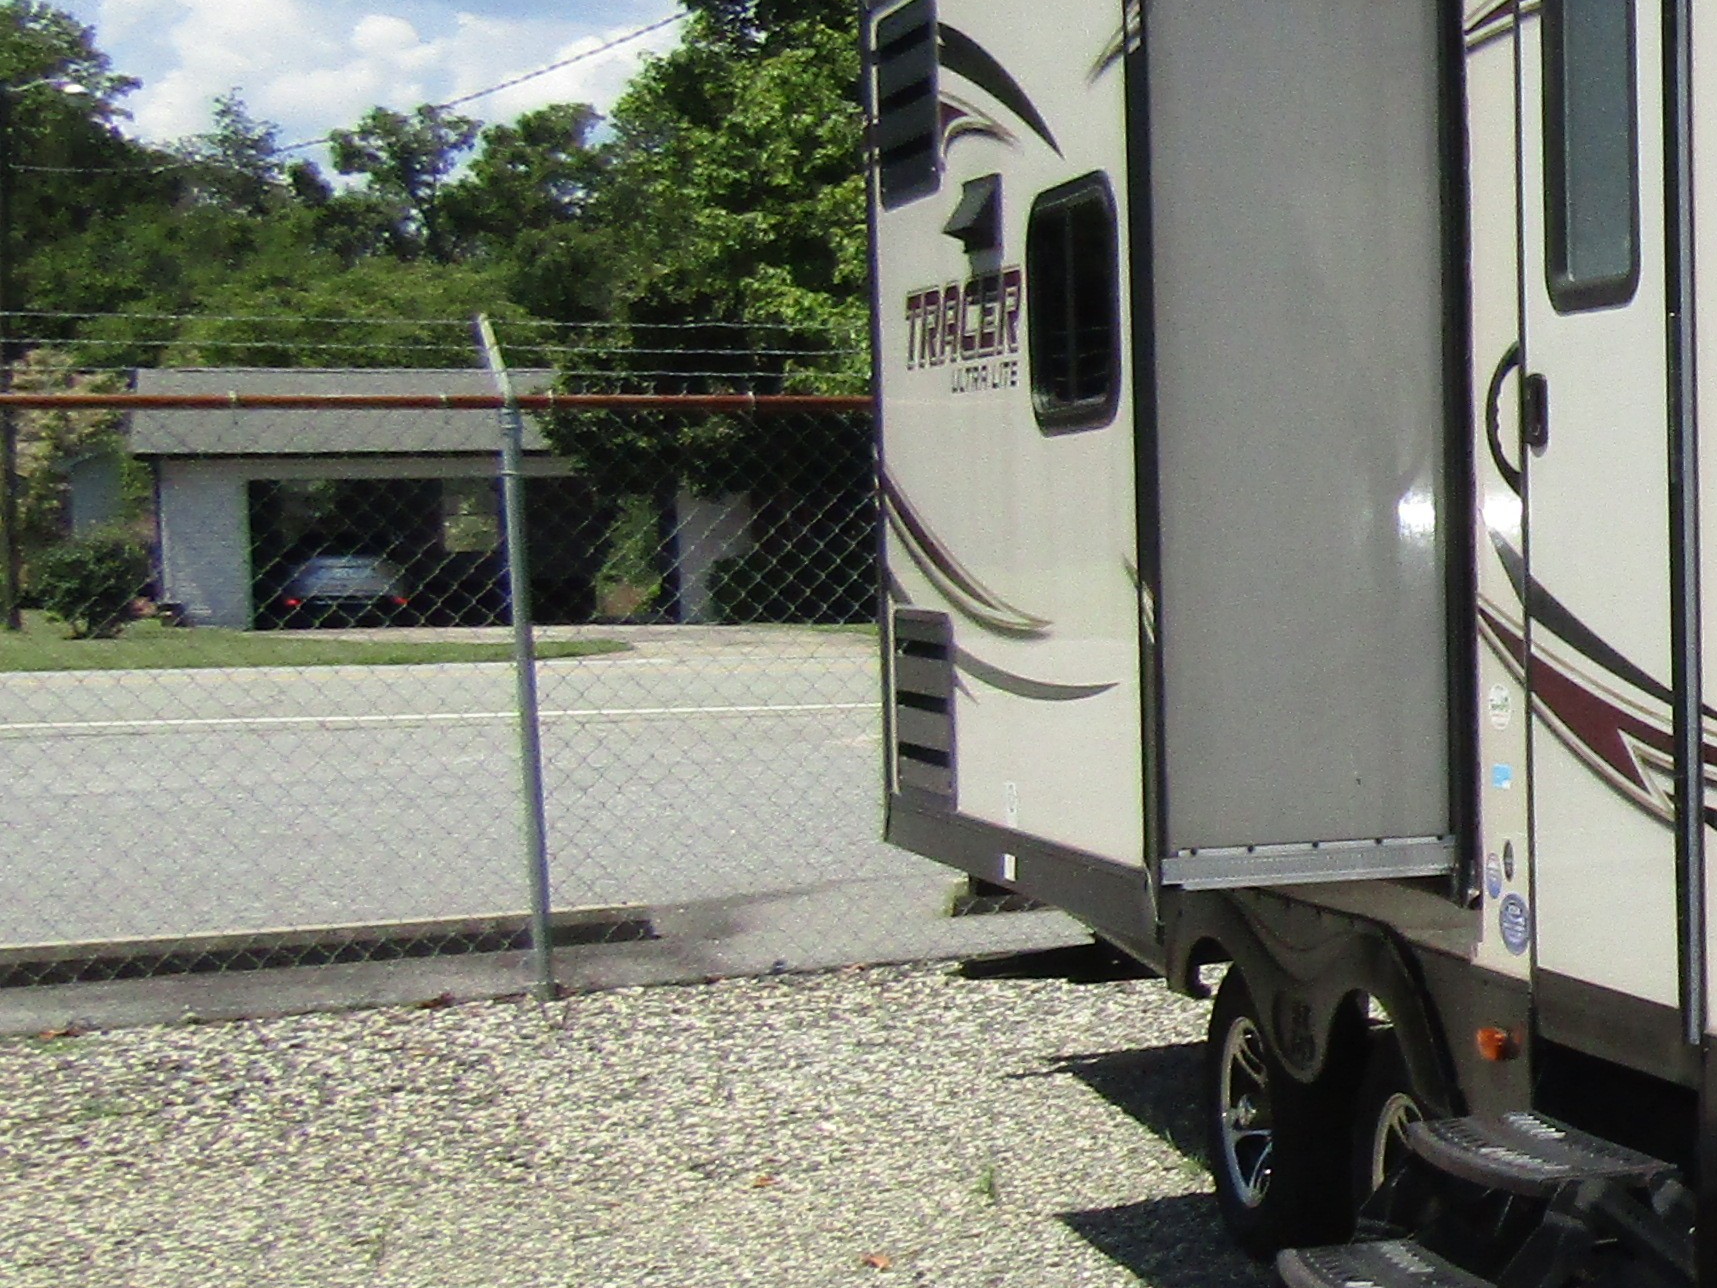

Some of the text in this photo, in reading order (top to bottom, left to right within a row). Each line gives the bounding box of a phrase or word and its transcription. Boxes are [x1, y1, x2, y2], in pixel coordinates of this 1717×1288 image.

[905, 264, 1021, 370] TRACER
[951, 361, 1019, 393] ULTRA LITE
